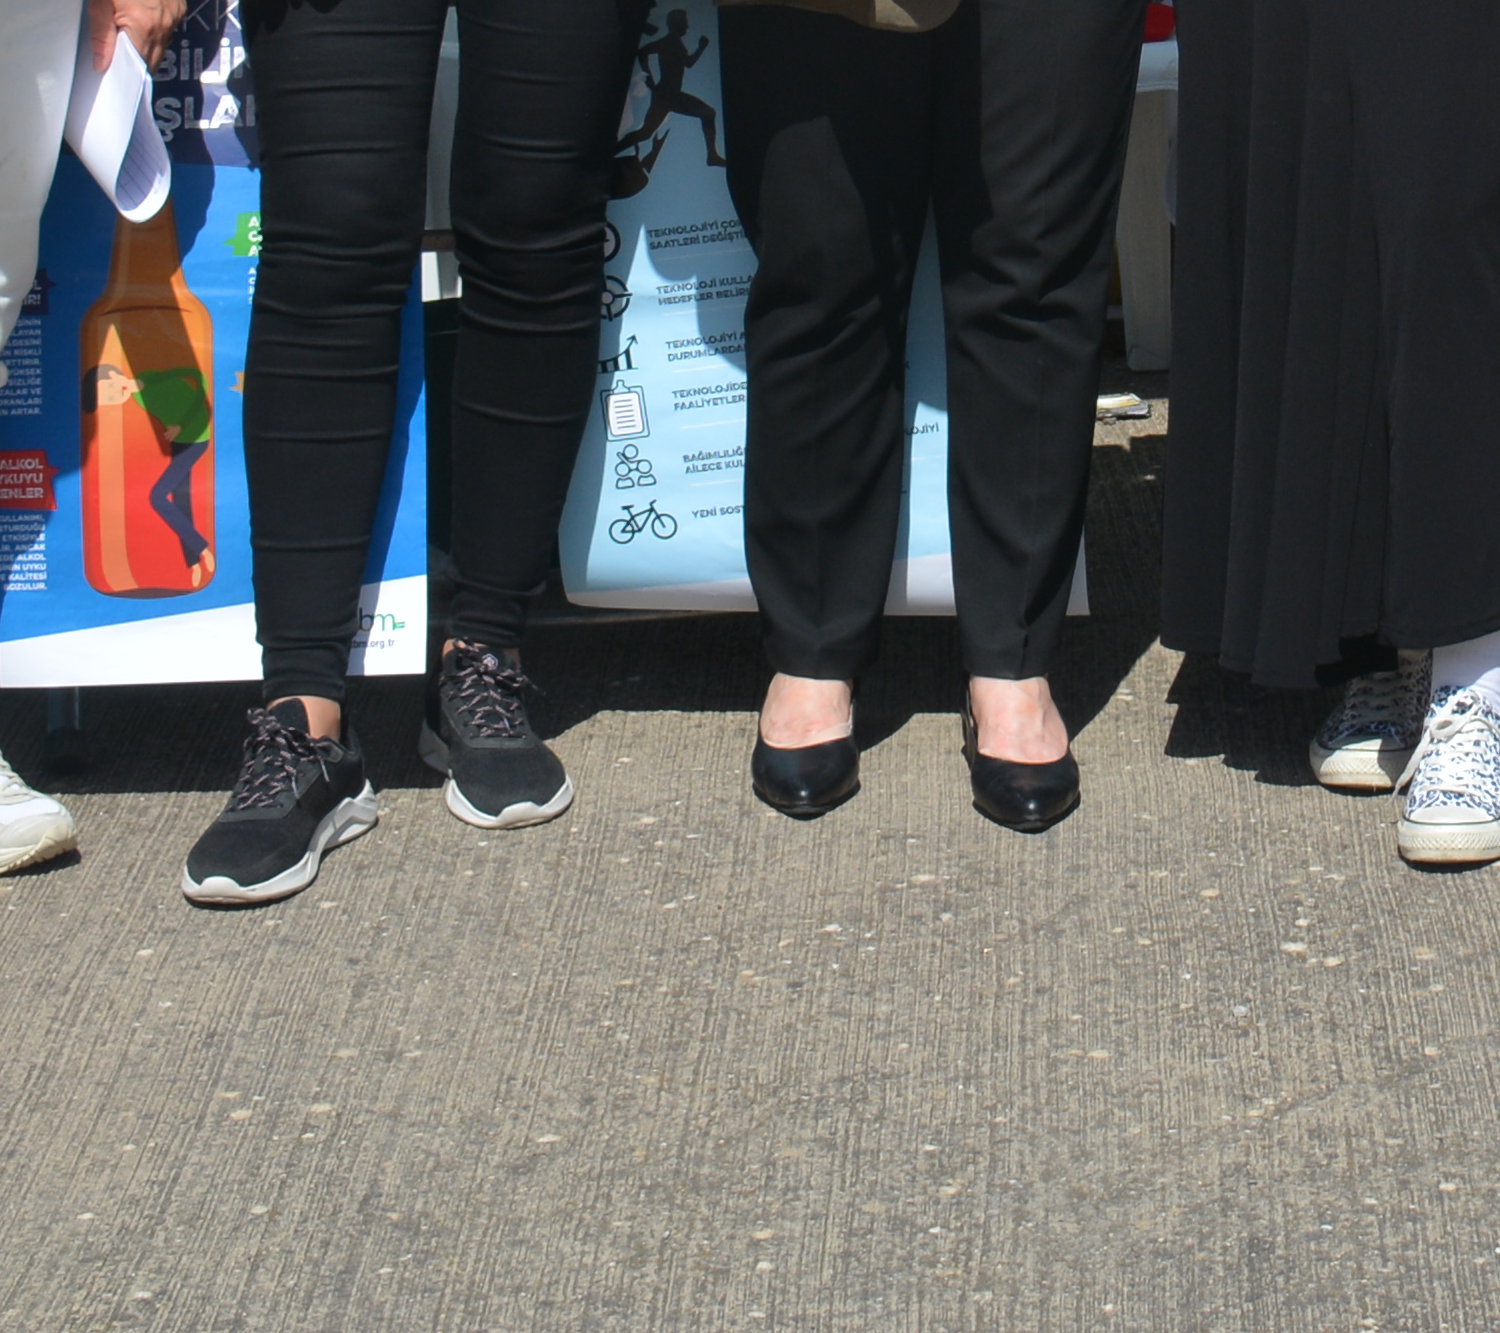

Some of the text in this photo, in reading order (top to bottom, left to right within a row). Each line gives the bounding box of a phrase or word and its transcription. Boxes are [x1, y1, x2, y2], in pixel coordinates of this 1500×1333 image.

[647, 220, 719, 239] TEKNOLOJİYİ
[649, 236, 700, 250] SAATLERİ
[656, 274, 753, 295] TEKNOLOJİ KULLA
[658, 287, 749, 306] HEDEFLER BELİR
[665, 330, 737, 350] TEKNOLOJİYİ
[667, 344, 745, 363] DURUMLARDA
[30, 387, 42, 395] VE
[672, 380, 747, 399] TEKNOLOJİDE
[682, 445, 746, 463] BAĞIMLILIĞ
[685, 461, 723, 475] AİLECE
[691, 505, 717, 519] YENİ
[15, 543, 46, 552] ANCAK
[16, 552, 46, 561] ALKOL
[22, 562, 47, 571] UYKU
[8, 571, 47, 581] KALİTESİ
[4, 582, 48, 591] BOZULUR.
